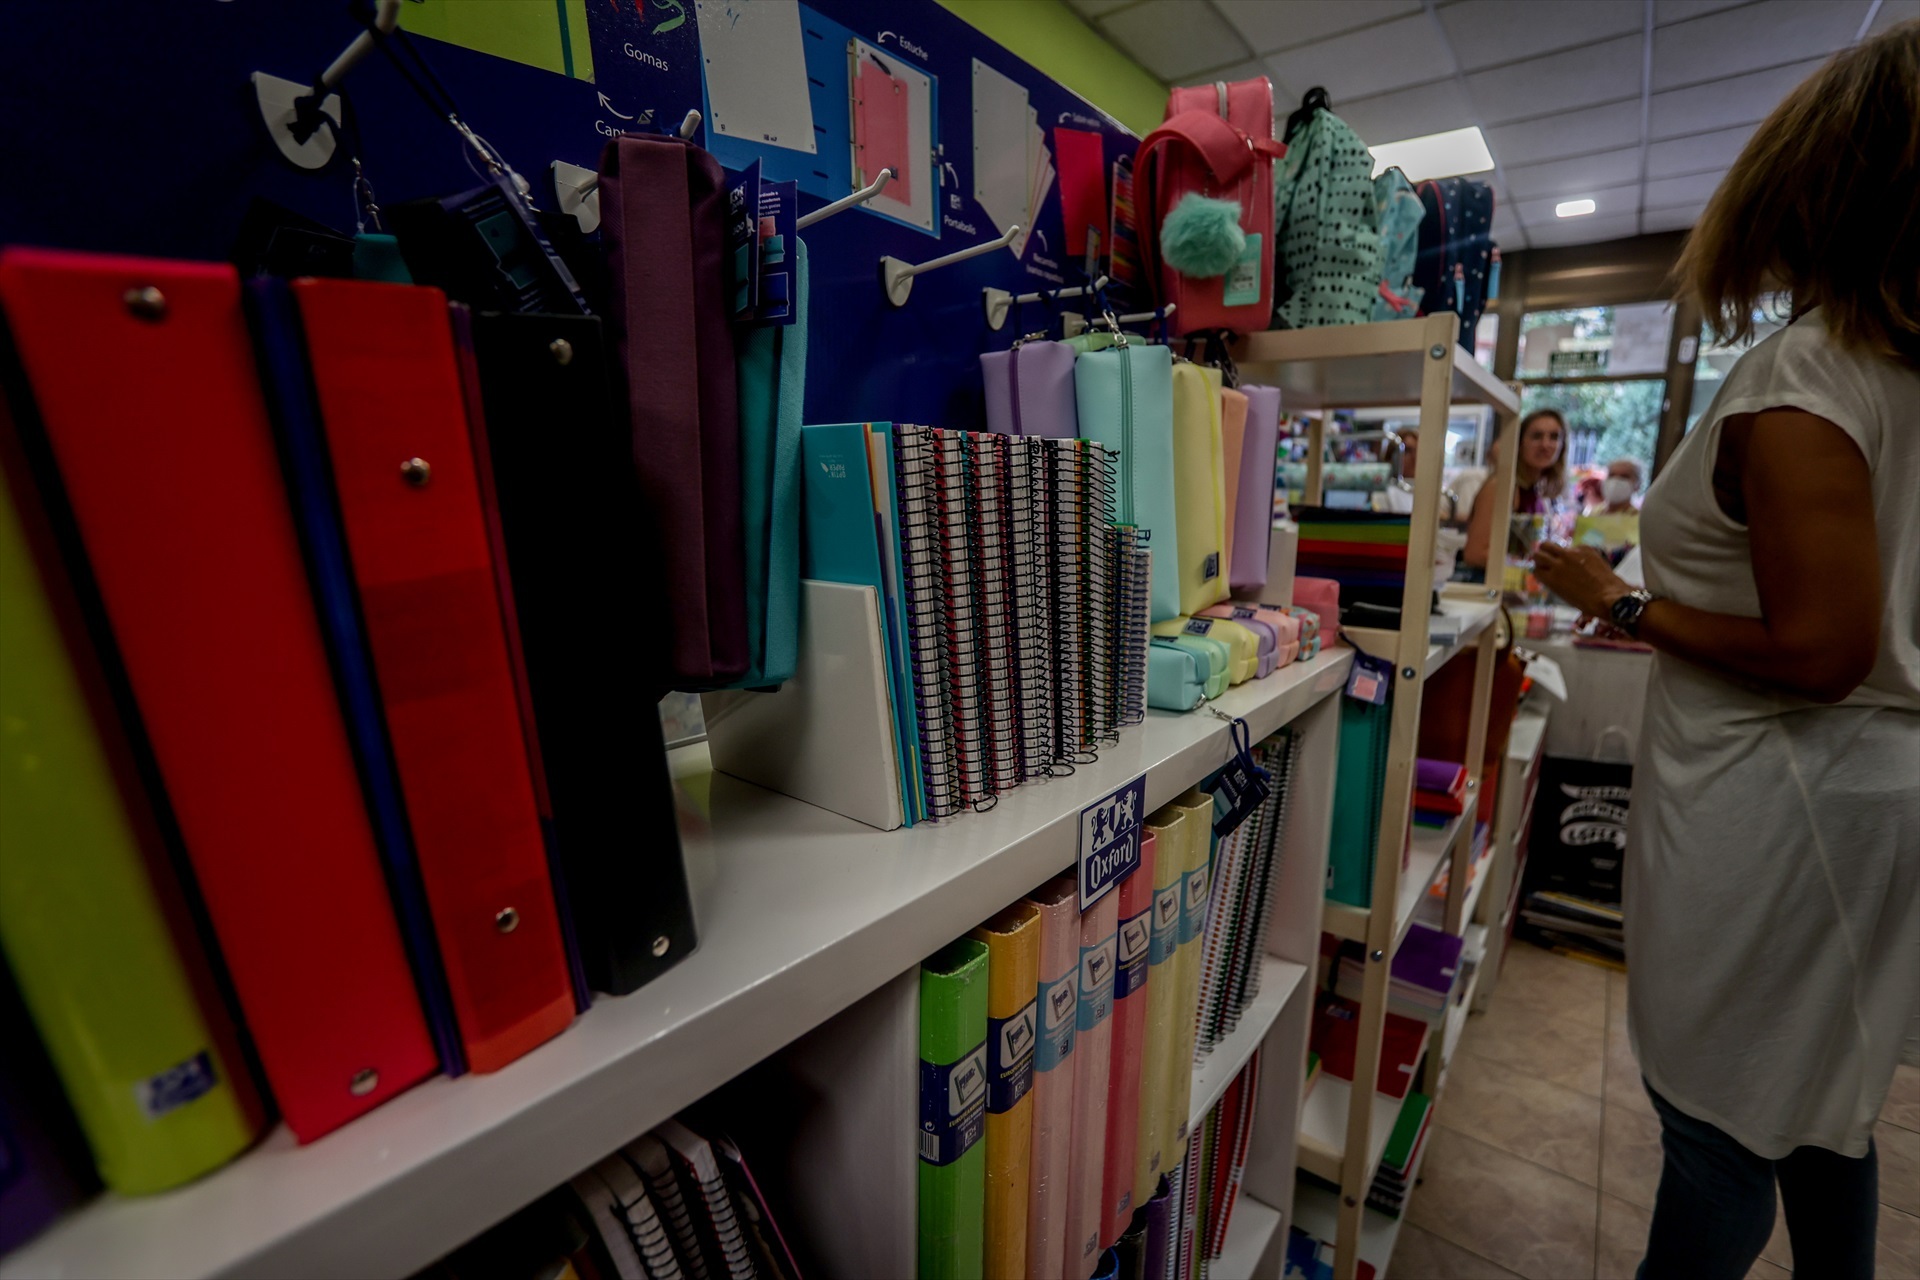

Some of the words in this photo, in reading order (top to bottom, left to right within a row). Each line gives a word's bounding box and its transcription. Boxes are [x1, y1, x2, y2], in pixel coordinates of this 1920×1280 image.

[623, 42, 669, 72] Gomas
[899, 35, 928, 61] Estuche
[1091, 832, 1134, 890] Oxford
